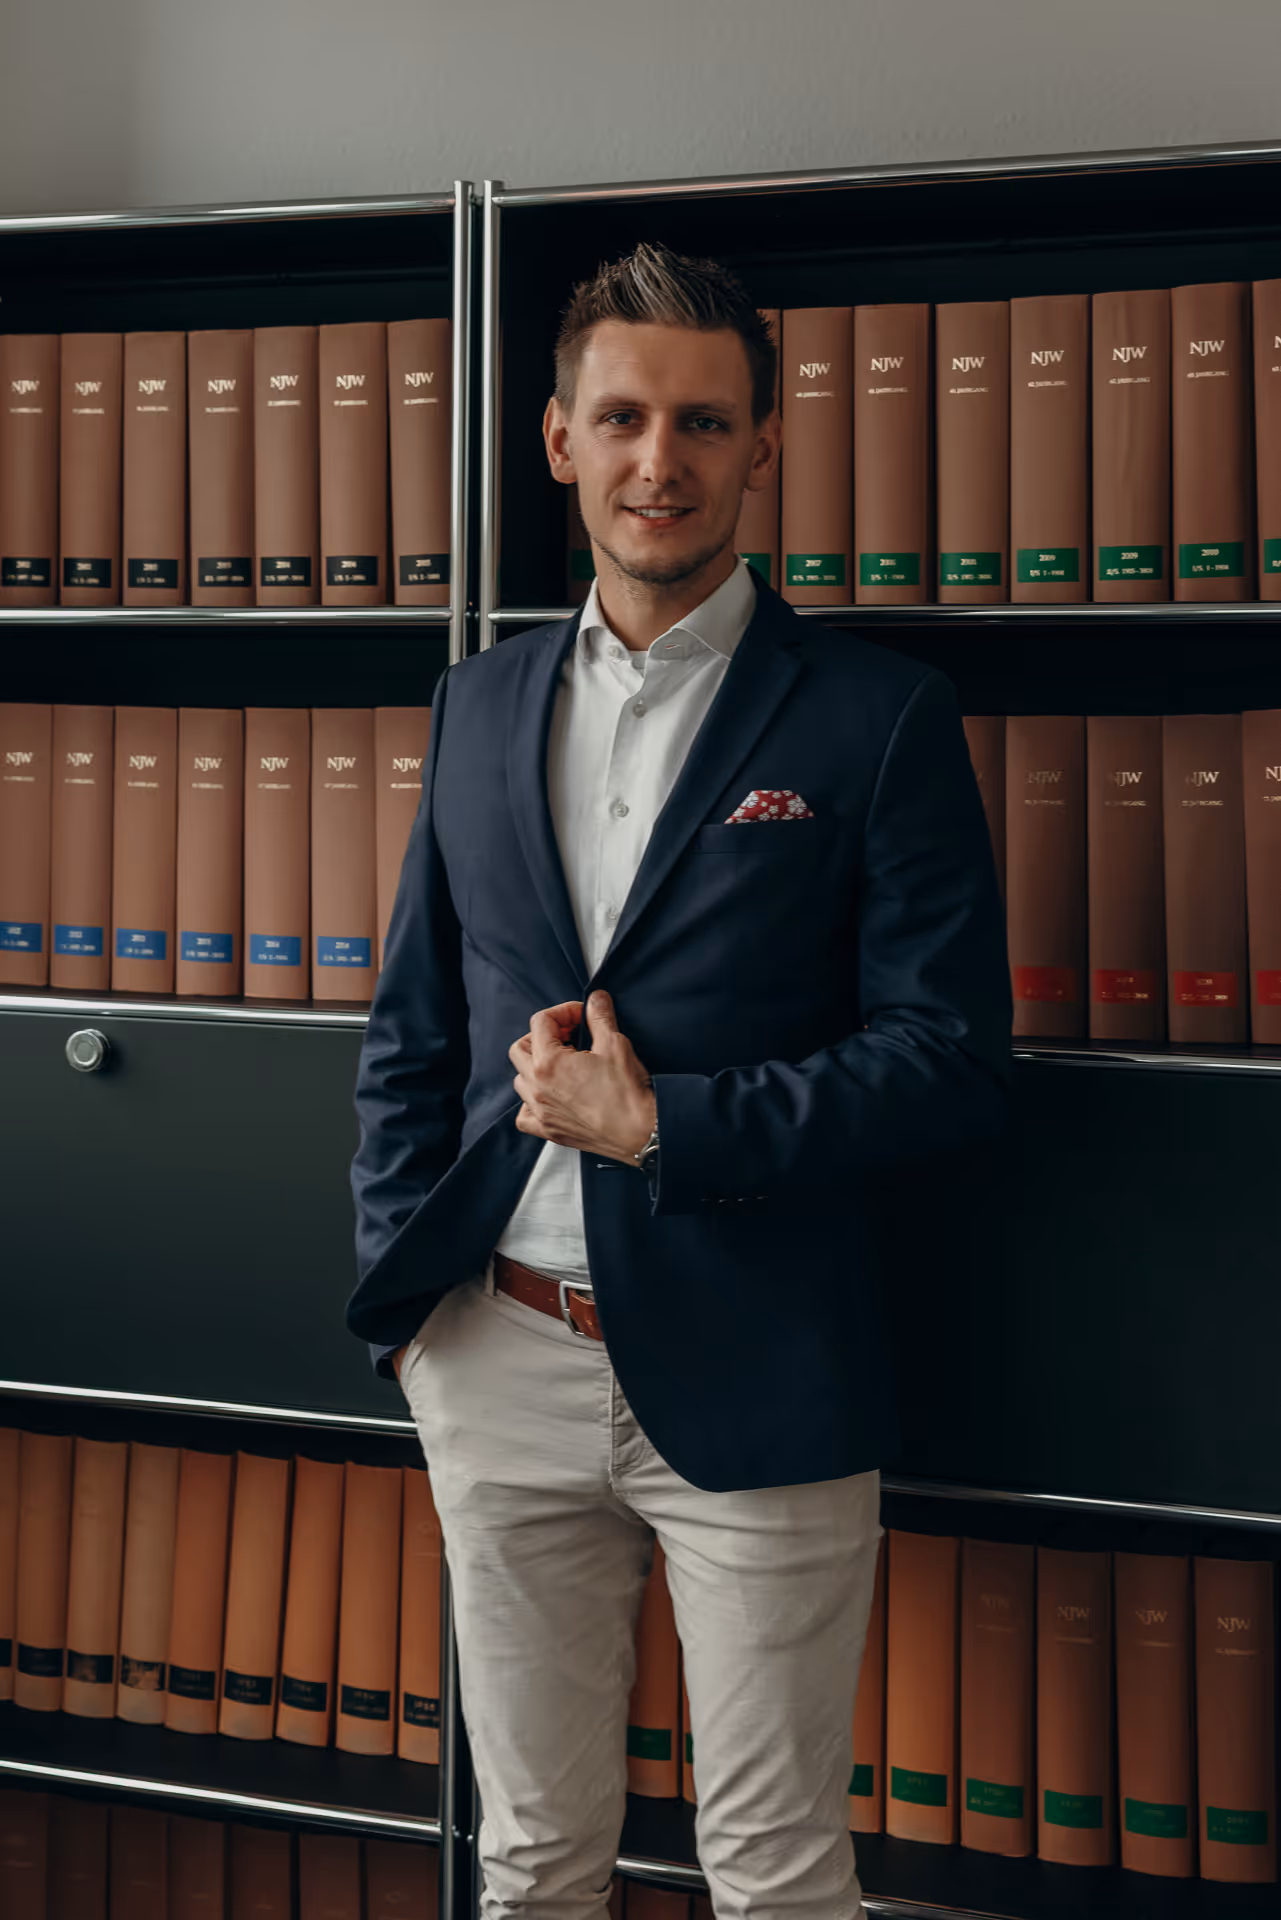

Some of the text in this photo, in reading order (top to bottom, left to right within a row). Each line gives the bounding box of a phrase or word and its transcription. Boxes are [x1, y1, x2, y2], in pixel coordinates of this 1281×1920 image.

[1112, 346, 1147, 362] NJW
[1190, 340, 1225, 356] NJW
[871, 357, 903, 372] NJW
[952, 357, 985, 372] NJW
[1031, 351, 1064, 366] NJW
[799, 363, 830, 378] NJW
[207, 380, 236, 393] NJW
[270, 375, 298, 390] NJW
[336, 375, 366, 389] NJW
[404, 372, 433, 387] NJW
[12, 380, 39, 394] NJW
[75, 382, 101, 395] NJW
[139, 380, 166, 394] NJW
[6, 752, 33, 766] NJW
[66, 753, 93, 766] NJW
[129, 755, 156, 769] NJW
[194, 757, 221, 771] NJW
[261, 757, 288, 771] NJW
[327, 757, 356, 771] NJW
[393, 758, 421, 772] NJW
[1217, 1617, 1250, 1633] NJW
